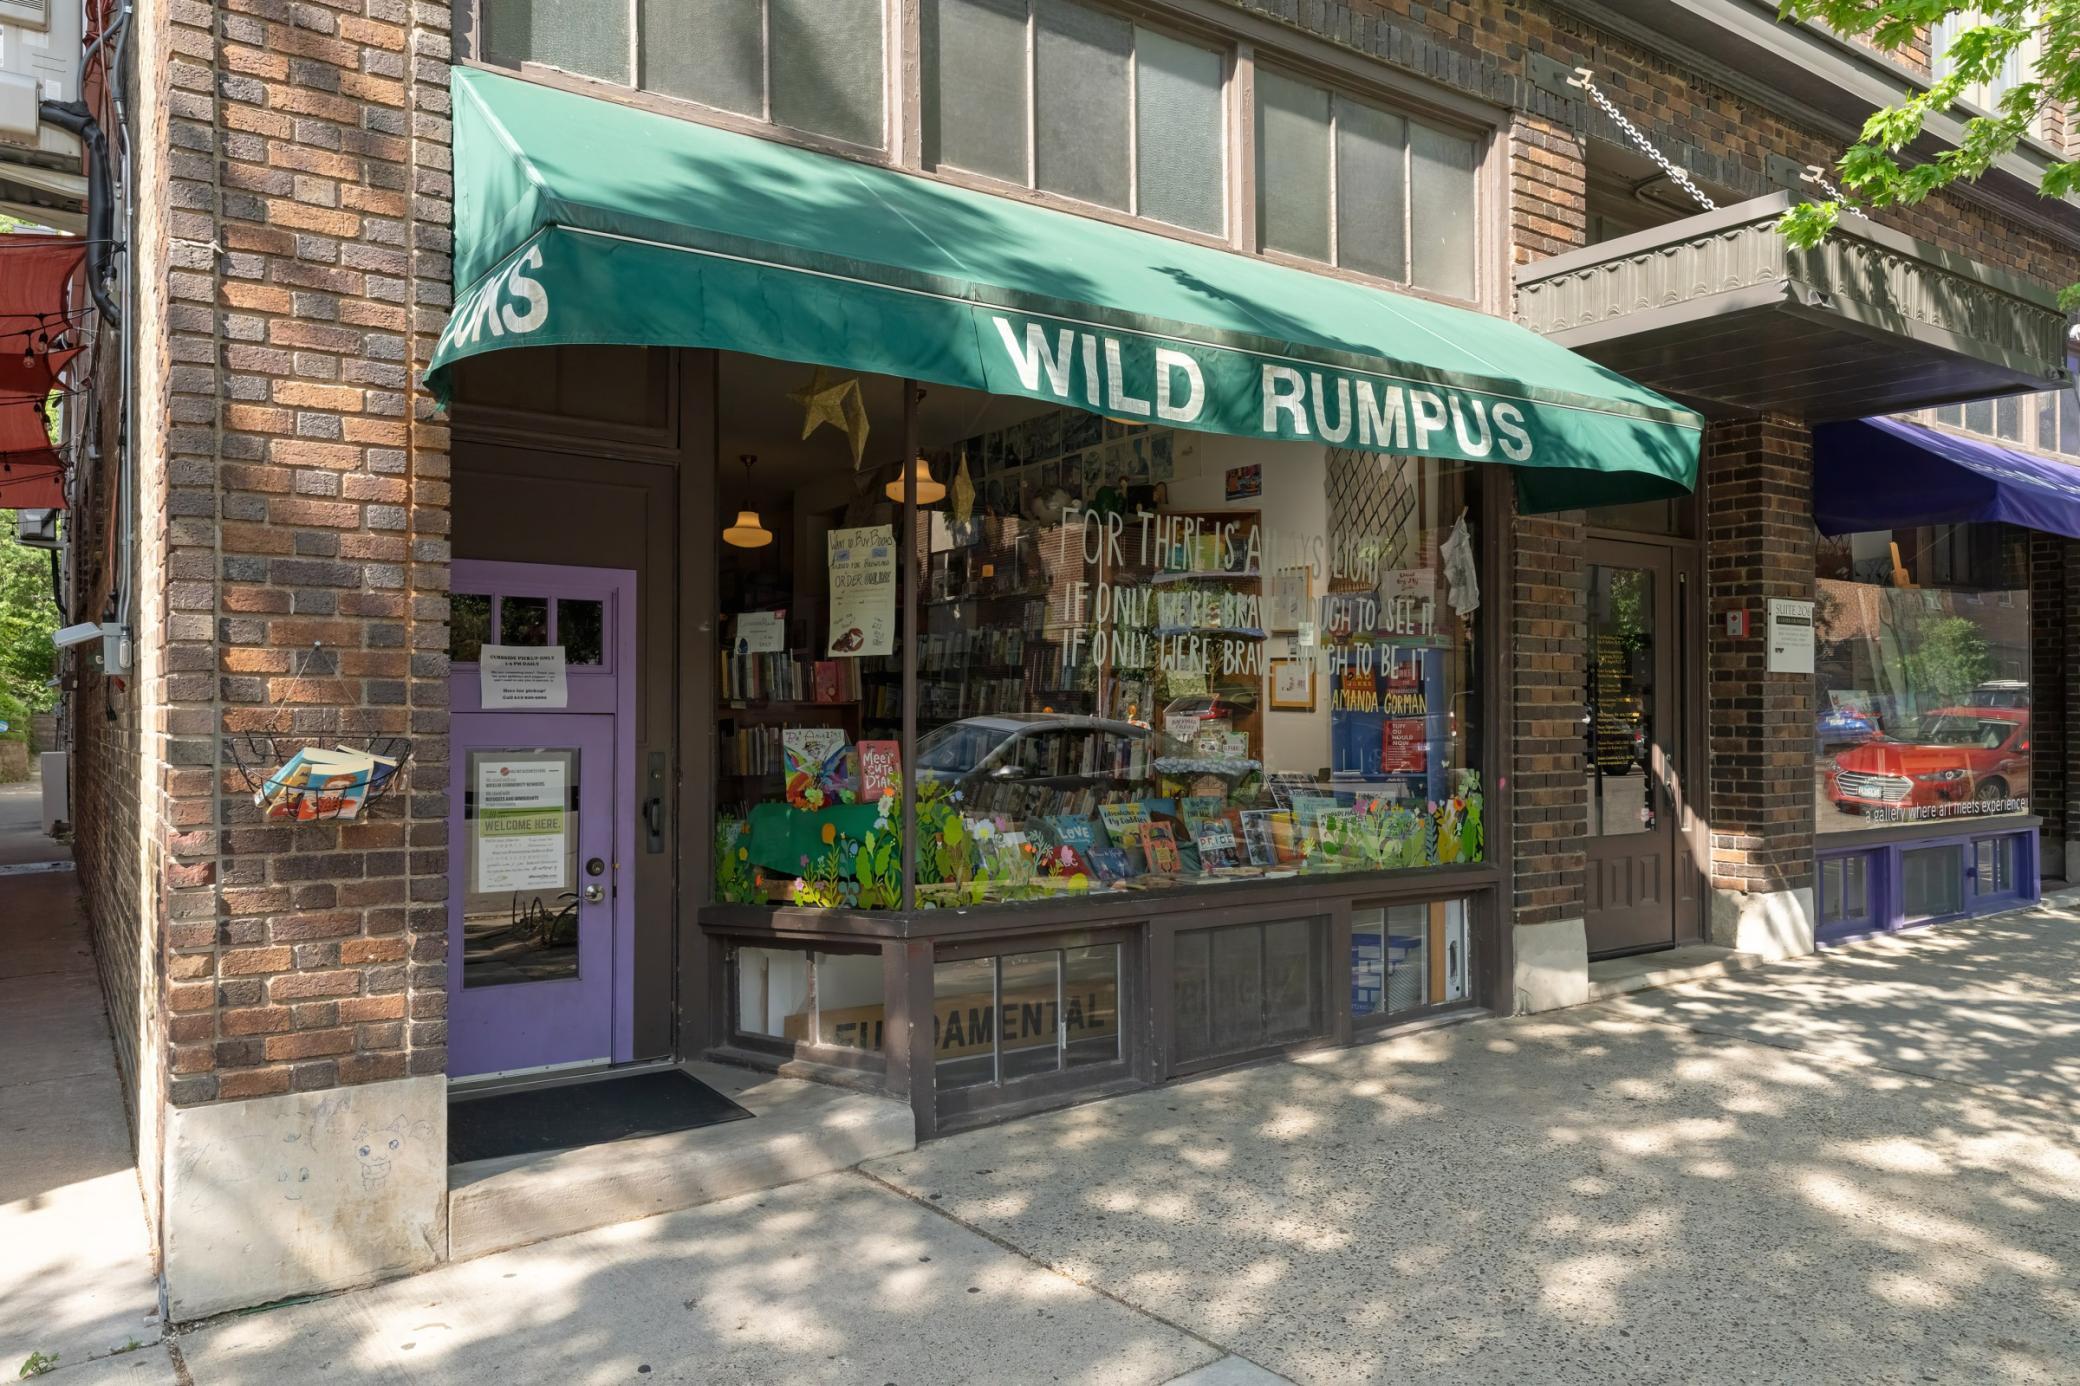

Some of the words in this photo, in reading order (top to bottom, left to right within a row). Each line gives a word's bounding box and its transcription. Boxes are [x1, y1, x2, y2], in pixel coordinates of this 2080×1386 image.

[992, 316, 1206, 423] WILD
[1262, 363, 1534, 462] RUMPUS
[1060, 507, 1124, 567] FOR
[1137, 511, 1205, 572] THERE
[1214, 521, 1235, 570] IS
[1064, 582, 1089, 622] IF
[1096, 582, 1153, 627] ONLY
[1357, 597, 1377, 633] TO
[1386, 598, 1416, 635] SEE
[1063, 628, 1087, 668] IF
[1092, 631, 1149, 669] ONLY
[1354, 642, 1373, 676] TO
[1381, 643, 1400, 680] BE
[1332, 689, 1379, 713] AMANDA
[1384, 692, 1428, 715] GORMAN
[485, 819, 532, 832] WELCOME
[534, 817, 561, 830] HERE.
[1057, 826, 1092, 842] LOVE
[1865, 810, 1872, 824] a
[1873, 805, 1906, 824] gallery
[1908, 801, 1937, 820] where
[1939, 802, 1953, 818] art
[1953, 800, 1980, 815] meets
[1981, 797, 2026, 816] experience
[834, 992, 1105, 1052] FUAMENTAL
